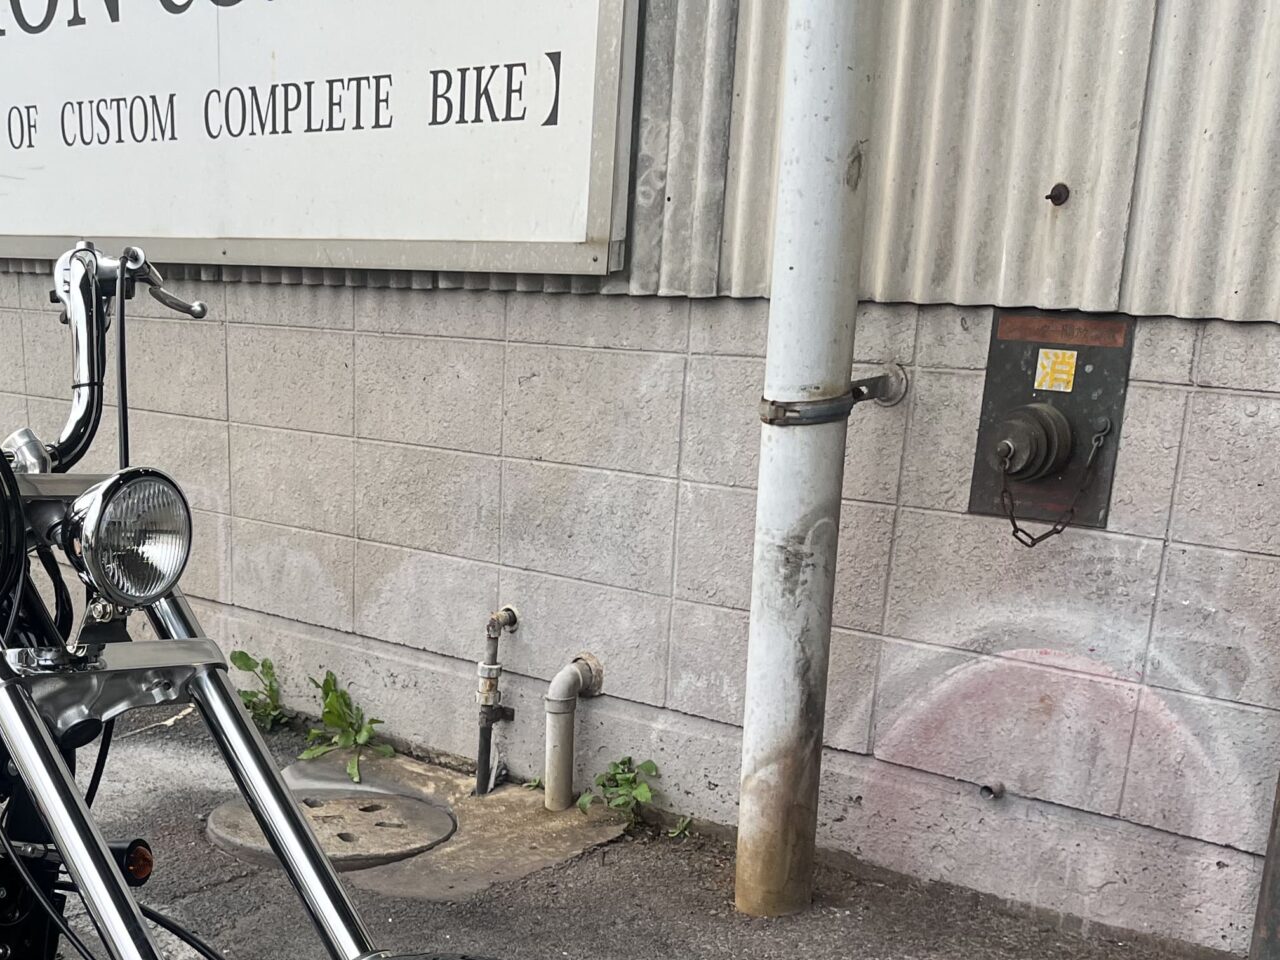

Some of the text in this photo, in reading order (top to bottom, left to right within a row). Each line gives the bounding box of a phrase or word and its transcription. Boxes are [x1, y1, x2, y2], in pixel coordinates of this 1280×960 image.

[7, 105, 38, 149] OF
[60, 93, 178, 146] CUSTOM
[204, 74, 393, 139] COMPLETE
[1037, 351, 1075, 389] 消
